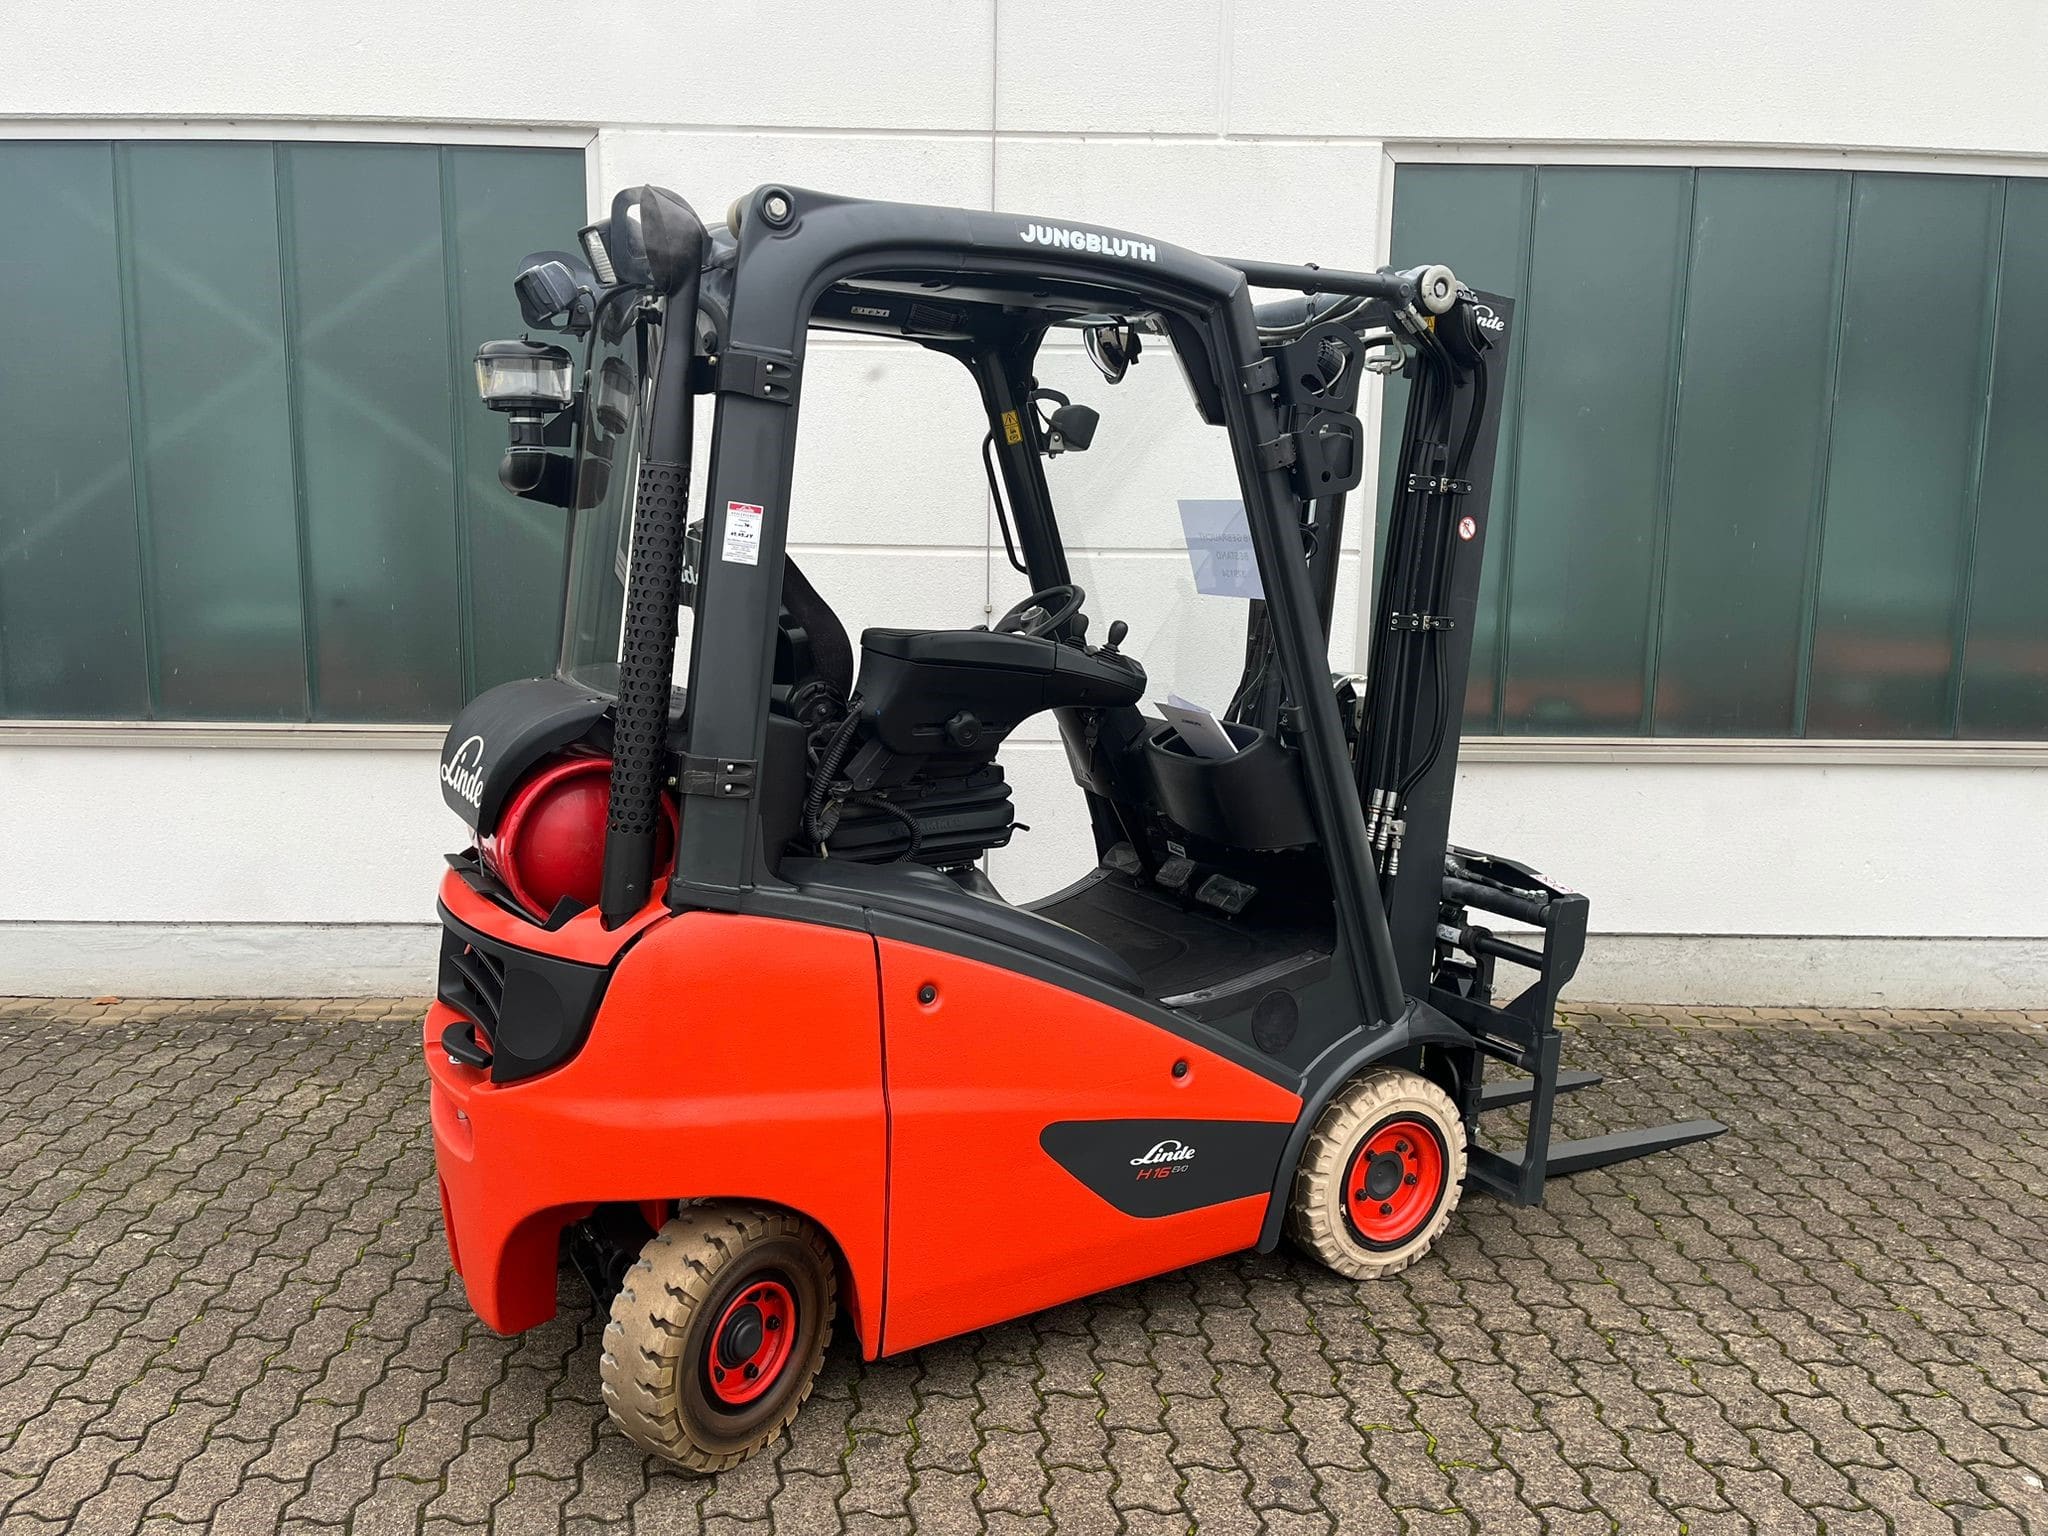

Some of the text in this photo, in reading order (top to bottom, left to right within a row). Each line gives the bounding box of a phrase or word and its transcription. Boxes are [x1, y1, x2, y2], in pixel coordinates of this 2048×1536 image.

[1020, 223, 1156, 262] JUNGBLUTH
[1472, 305, 1505, 331] nde
[441, 735, 484, 808] Linde
[1129, 1140, 1196, 1165] Linde
